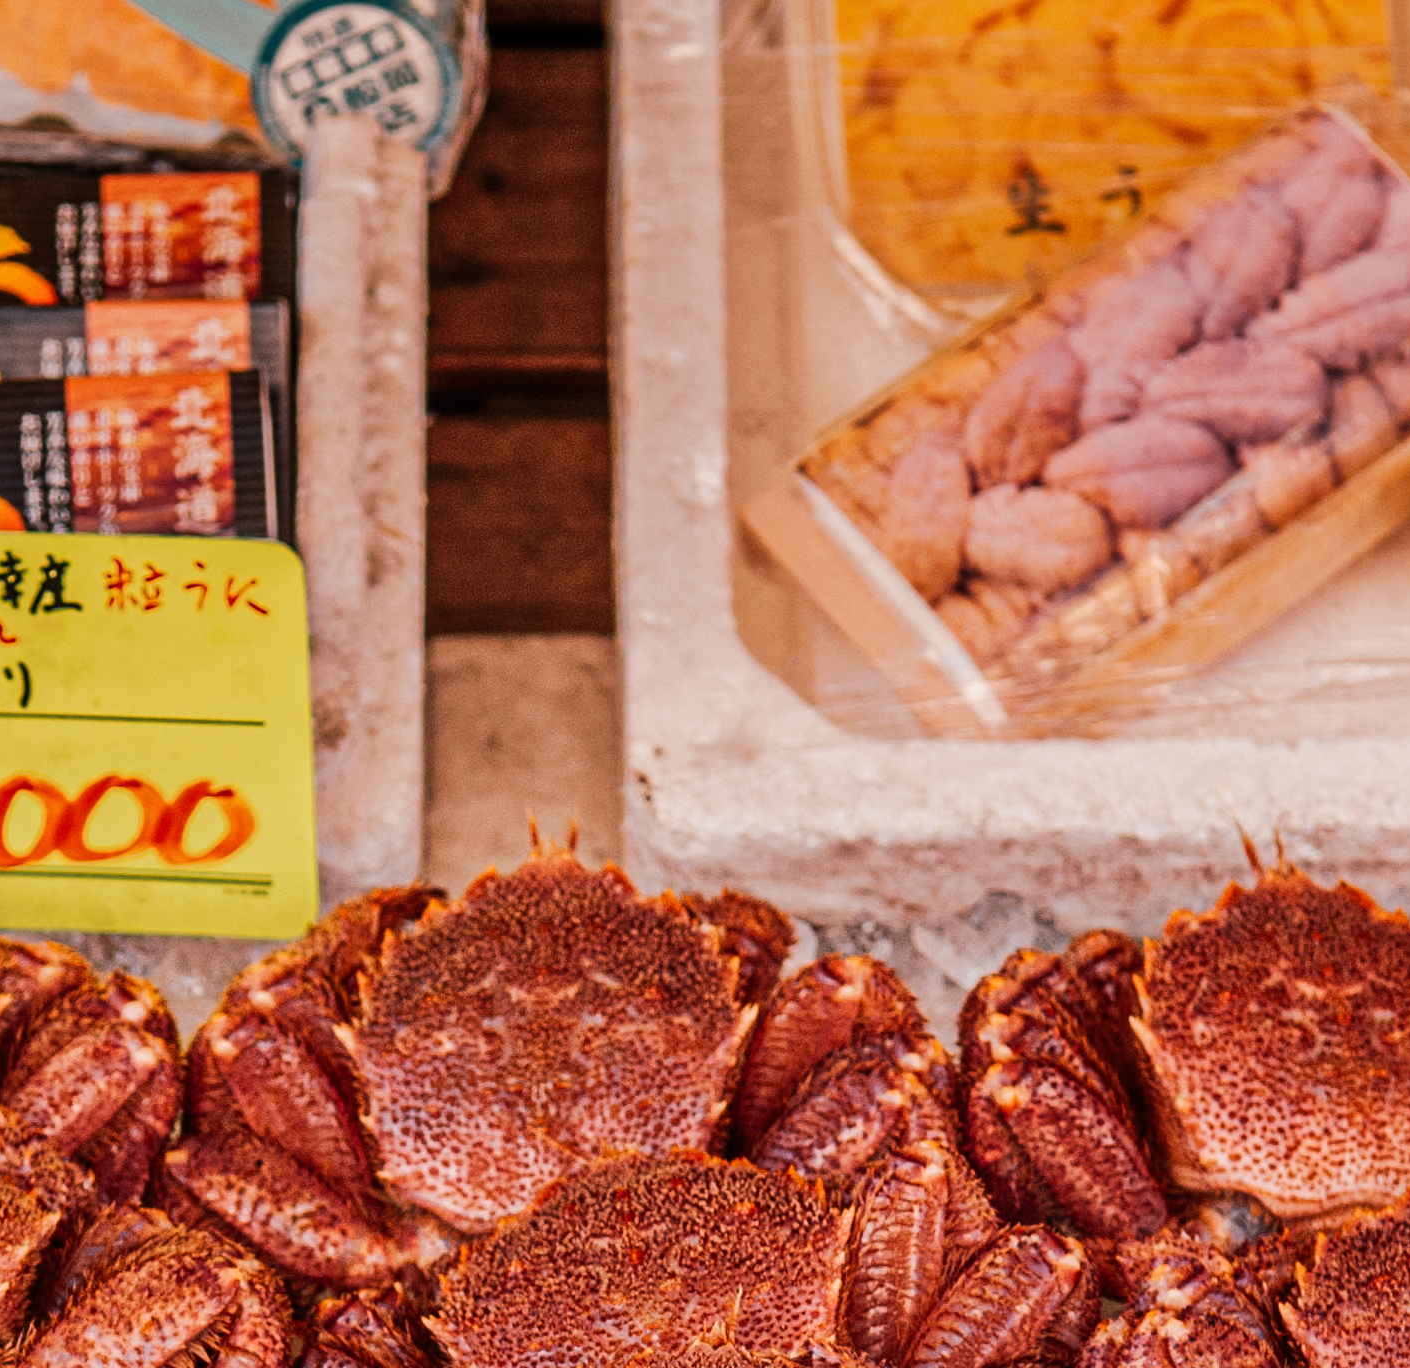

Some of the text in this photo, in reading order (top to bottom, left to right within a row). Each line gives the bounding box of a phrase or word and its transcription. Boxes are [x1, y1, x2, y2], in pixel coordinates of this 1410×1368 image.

[171, 385, 227, 533] 北海道
[102, 556, 269, 616] 粒うに
